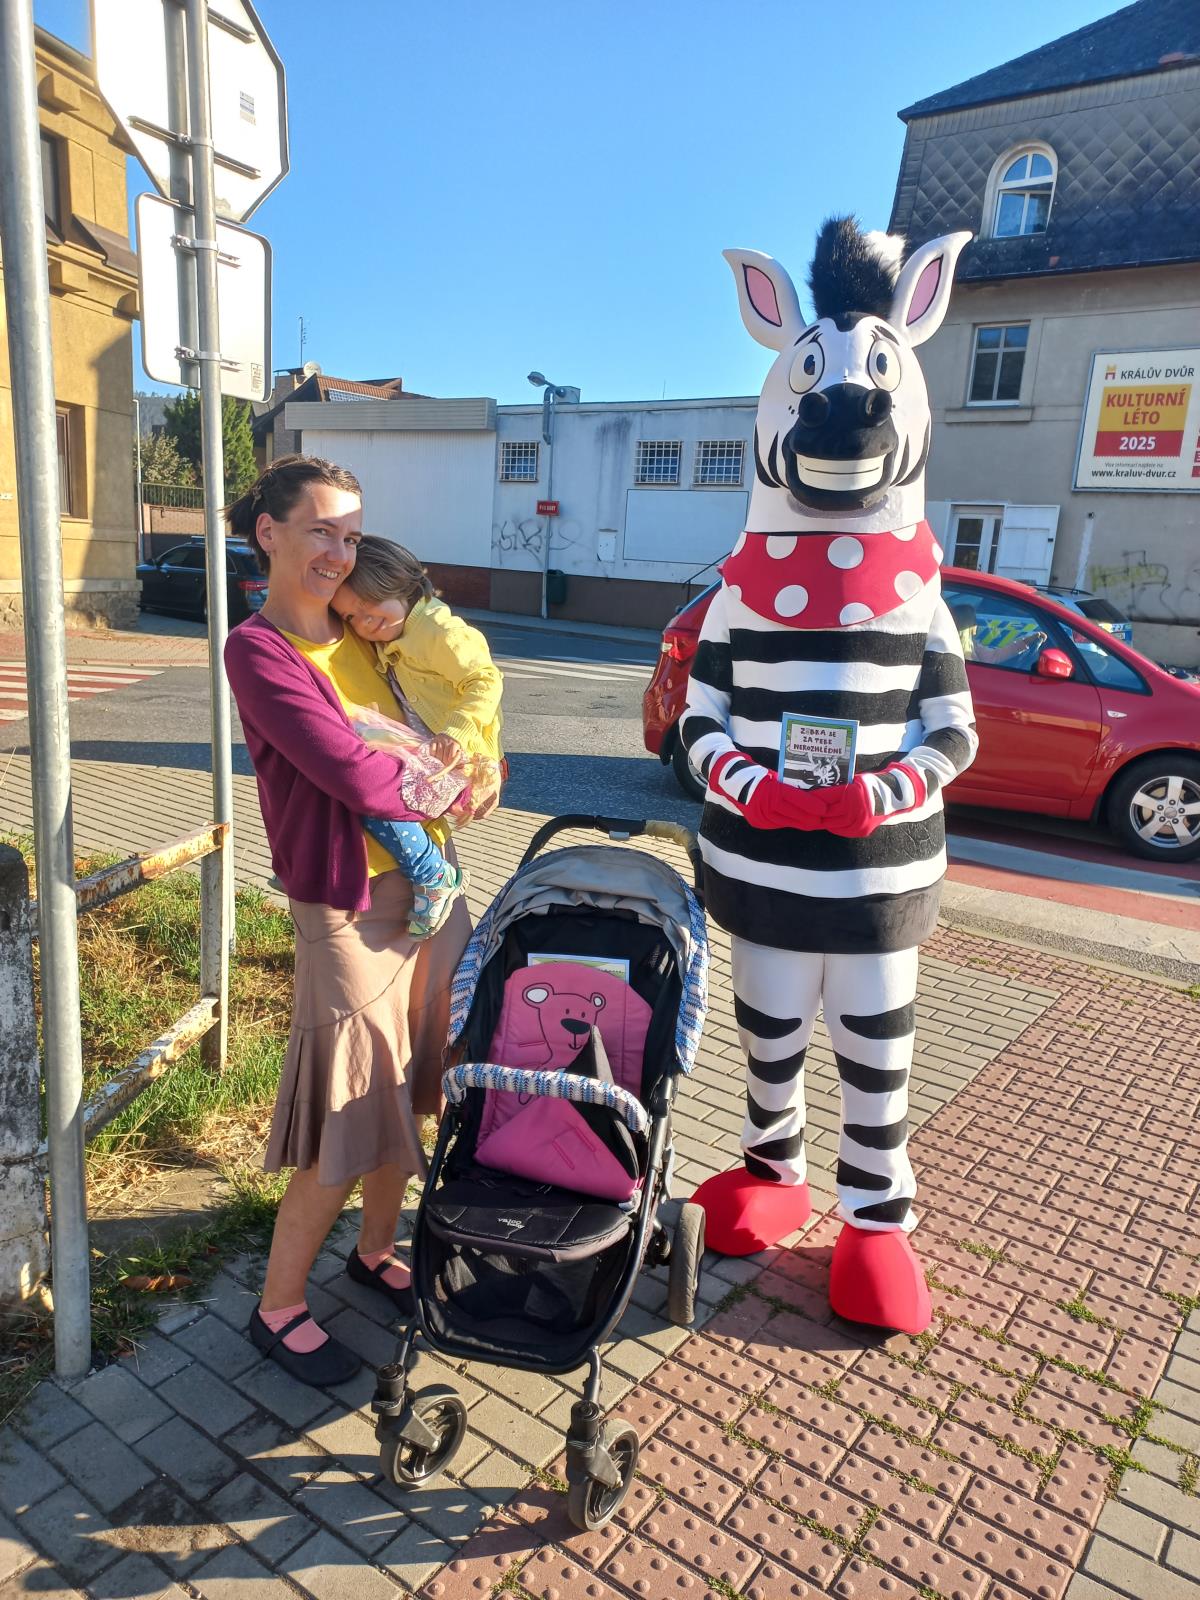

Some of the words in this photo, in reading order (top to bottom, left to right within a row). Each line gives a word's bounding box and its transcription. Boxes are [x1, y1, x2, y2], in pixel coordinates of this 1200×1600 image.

[1120, 366, 1162, 380] KRÁLŮV
[1164, 365, 1195, 378] DVŮR
[1106, 388, 1187, 408] KULTURNÍ
[1123, 408, 1161, 425] LÉTO
[1119, 436, 1157, 451] 2025
[1091, 469, 1177, 478] www.kraluv-dvur.cz
[815, 737, 832, 745] TEBE
